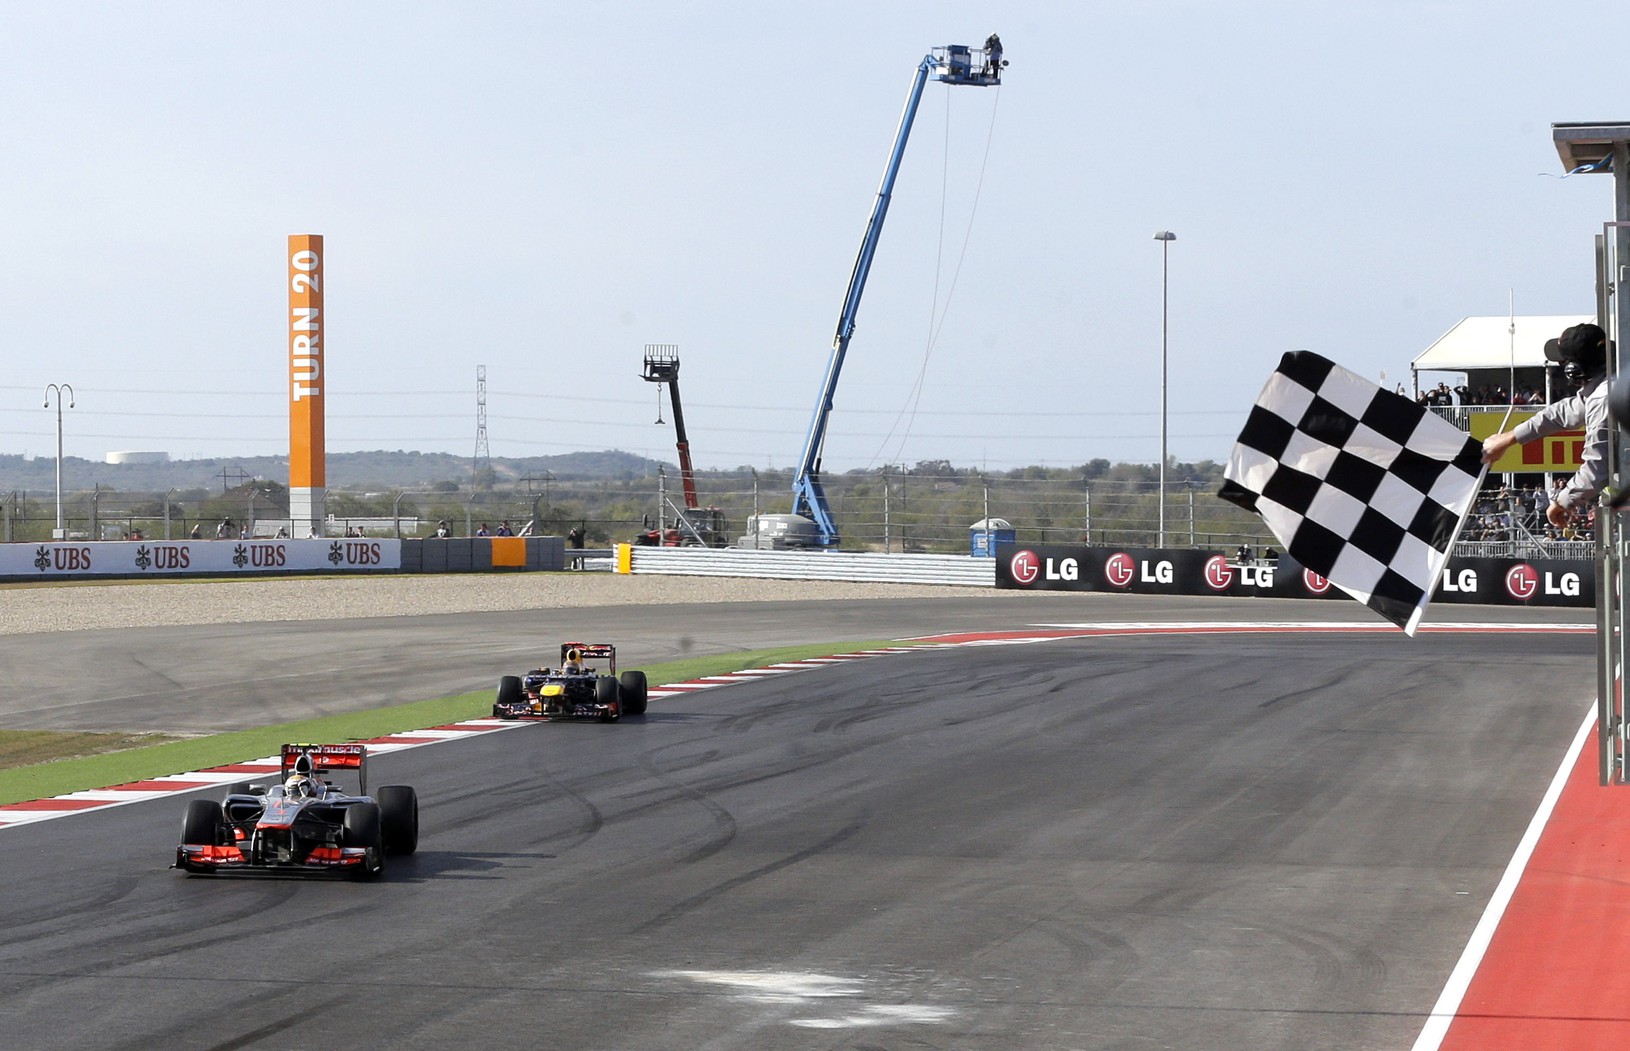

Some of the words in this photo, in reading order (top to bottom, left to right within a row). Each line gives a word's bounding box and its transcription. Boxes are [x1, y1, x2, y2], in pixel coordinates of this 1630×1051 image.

[292, 250, 319, 294] 20
[292, 307, 320, 402] TURN
[53, 547, 91, 570] UBS
[154, 546, 190, 569] UBS
[250, 545, 286, 567] UBS
[346, 543, 381, 565] UBS
[1046, 557, 1079, 580] LG
[1141, 560, 1174, 584] LG
[1240, 565, 1274, 588] LG
[1442, 568, 1478, 592] LG
[1544, 571, 1580, 596] LG
